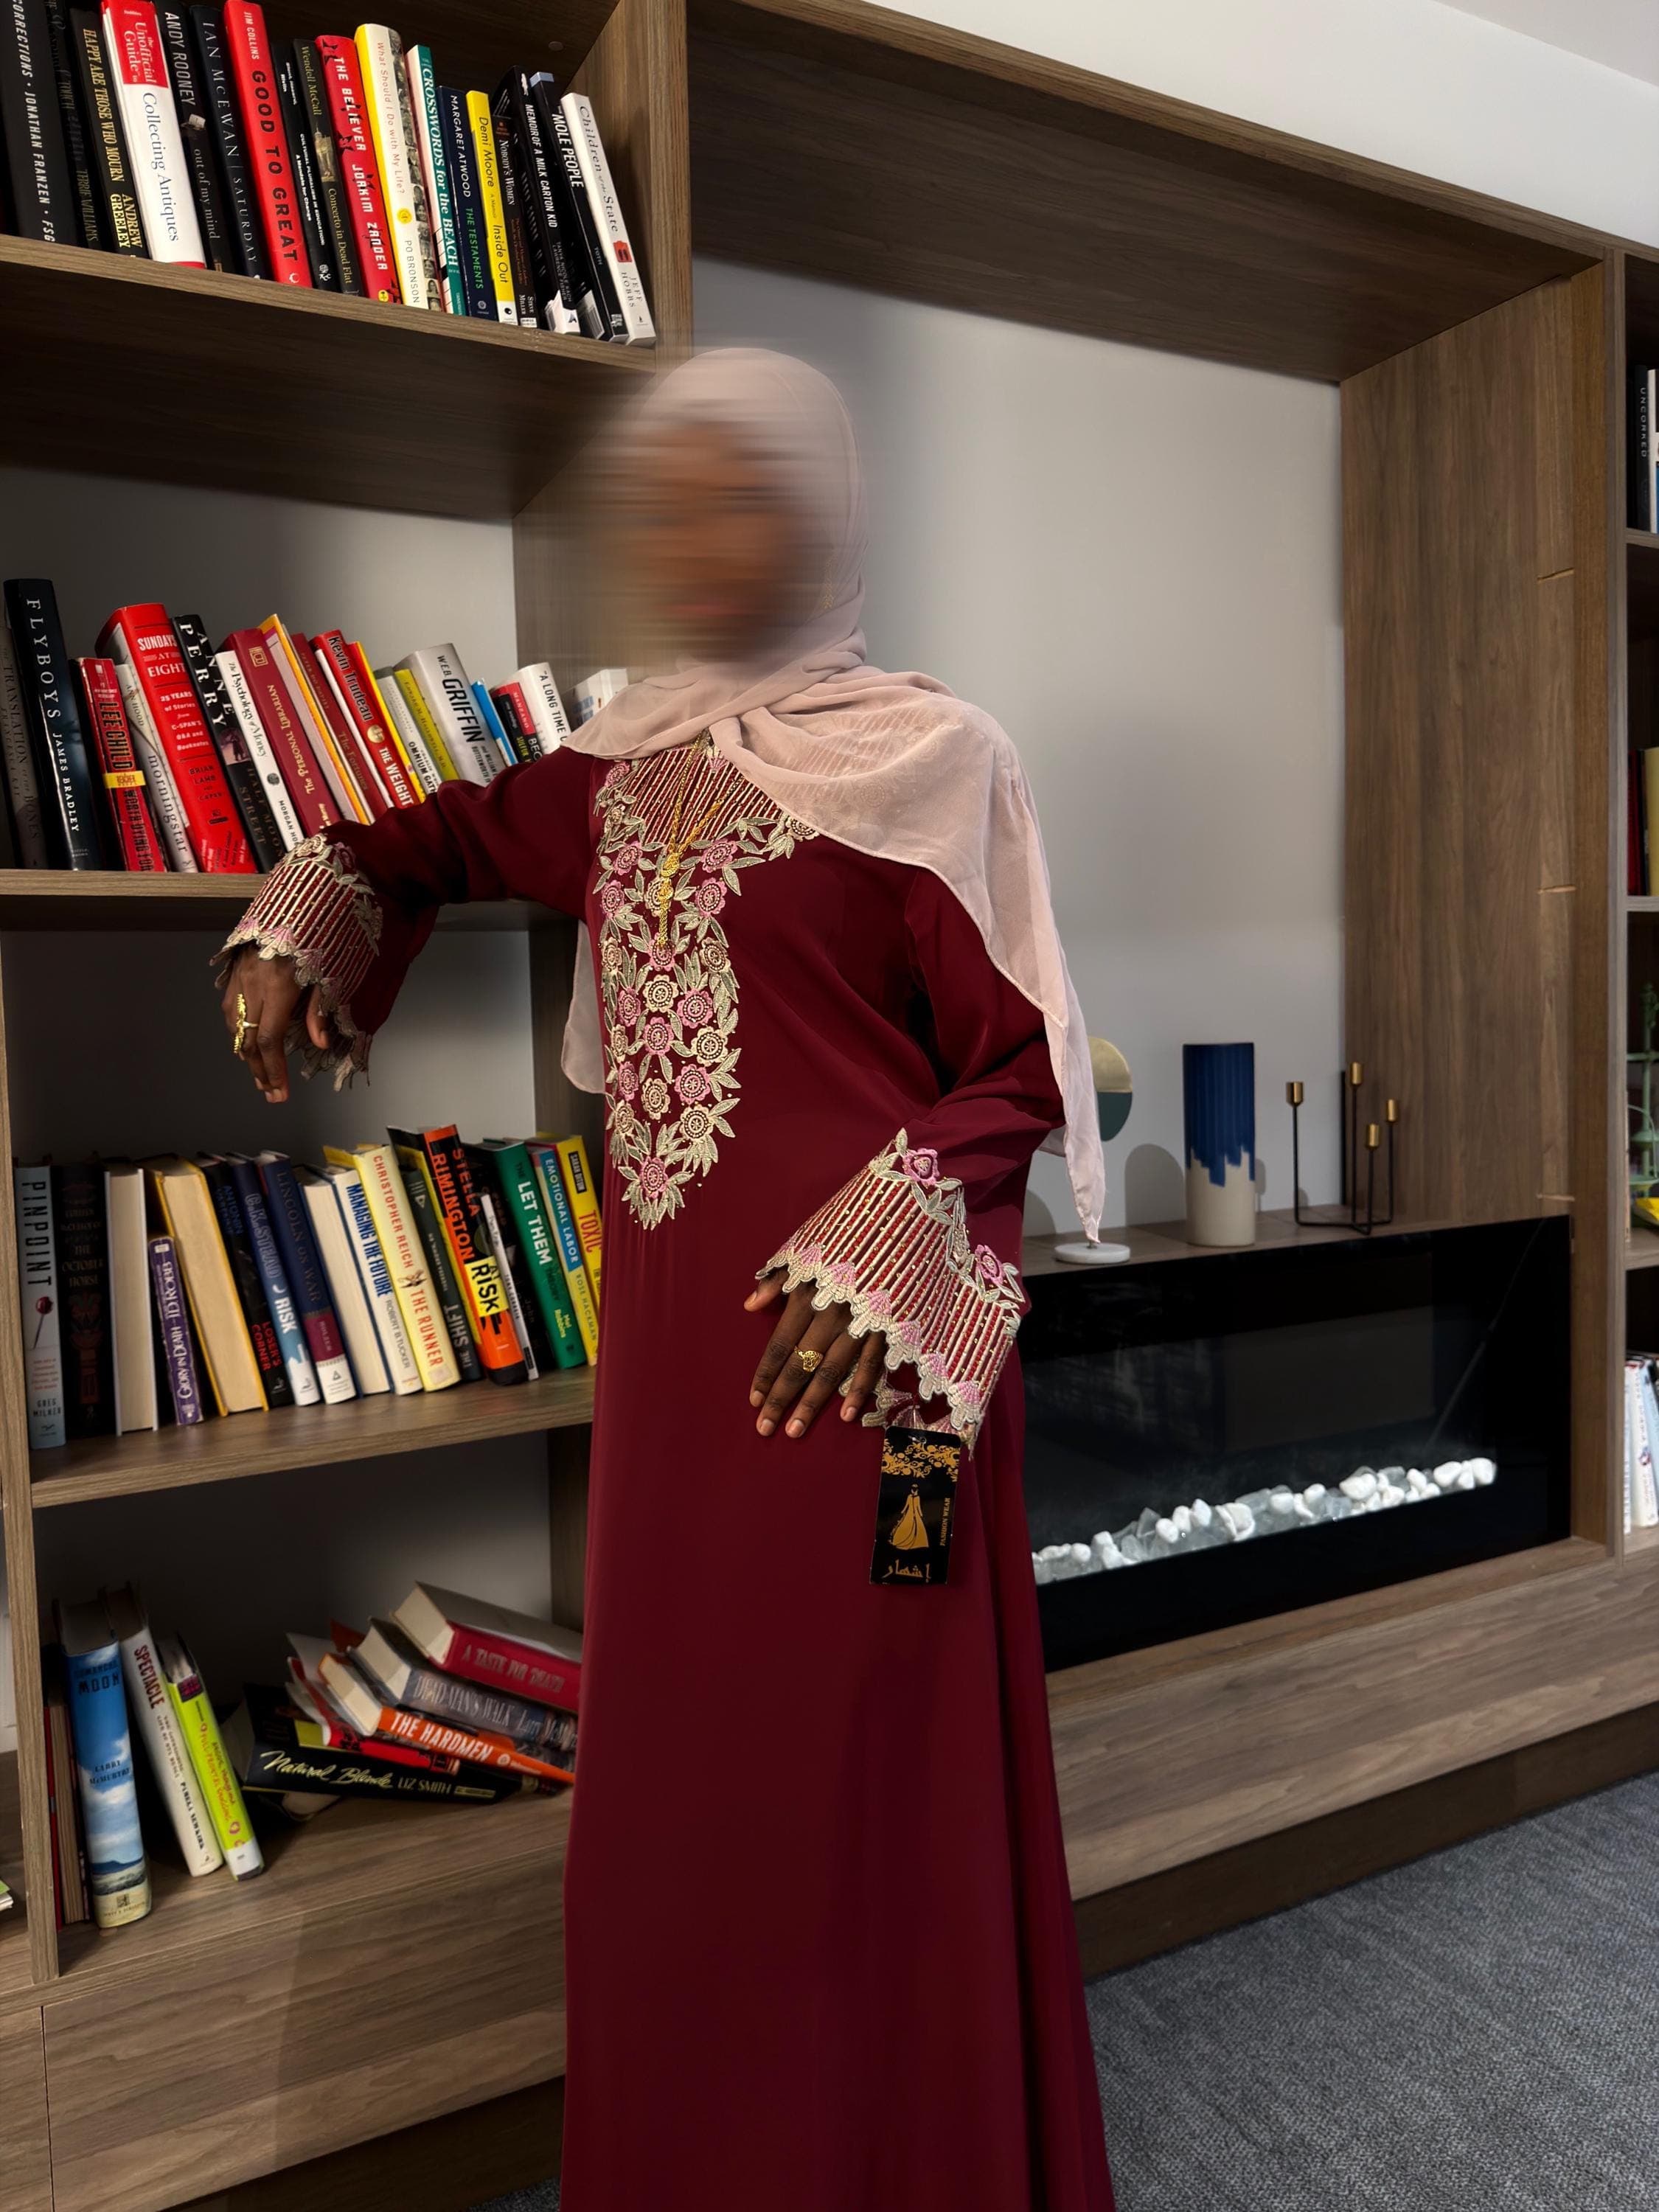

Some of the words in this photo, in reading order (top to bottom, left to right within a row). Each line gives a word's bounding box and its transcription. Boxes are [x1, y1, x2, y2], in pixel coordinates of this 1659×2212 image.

[164, 12, 184, 47] ANDY
[244, 11, 254, 25] JIM
[83, 28, 102, 62] HAPPY
[136, 22, 156, 83] Unofficial
[203, 23, 221, 58] IAN
[246, 27, 260, 60] COLLINS
[378, 42, 386, 66] What
[90, 62, 106, 86] ARE
[173, 52, 195, 105] ROONEY
[301, 46, 316, 82] Wendell
[309, 84, 322, 115] McCall
[334, 57, 349, 80] THE
[380, 70, 392, 102] Should
[94, 88, 112, 119] THOSE
[251, 70, 274, 132] GOOD
[341, 88, 366, 151] BELIEVER
[422, 68, 445, 167] CROSSWORDS
[101, 121, 116, 144] WHO
[386, 114, 394, 127] Do
[450, 95, 466, 150] MARGARET
[479, 116, 490, 147] Demi
[525, 104, 538, 136] MEMOIR
[552, 114, 572, 145] MOLE
[532, 137, 541, 147] OF
[580, 106, 602, 172] Children
[24, 91, 42, 147] JONATHAN
[33, 153, 50, 204] FRANZEN
[42, 219, 55, 242] FSG
[105, 147, 125, 182] MOURN
[143, 93, 165, 170] Collecting
[158, 175, 178, 241] Antiques
[194, 149, 204, 168] out
[265, 146, 282, 174] TO
[392, 153, 400, 167] My
[457, 152, 471, 198] ATWOOD
[484, 150, 494, 187] Moore
[535, 157, 548, 177] MILK
[561, 147, 584, 188] PEOPLE
[198, 173, 210, 186] of
[199, 187, 210, 204] my
[394, 170, 405, 193] Life?
[436, 169, 446, 189] for
[504, 176, 515, 205] WOMEN
[540, 180, 555, 212] CARTON
[81, 198, 99, 241] WILLIAMS
[110, 194, 131, 248] GREELEY
[122, 194, 142, 248] ANDREW
[234, 177, 257, 262] SATURDAY
[328, 188, 341, 228] Concerto
[352, 164, 374, 212] JOAKIM
[367, 222, 389, 270] ZANDER
[439, 193, 450, 214] the
[465, 208, 474, 227] THE
[547, 213, 558, 229] KID
[603, 195, 619, 232] State
[204, 209, 220, 238] mind
[273, 187, 297, 260] GREAT
[335, 228, 345, 240] in
[442, 218, 458, 265] BEACH
[493, 224, 506, 258] Inside
[338, 243, 350, 267] Dead
[405, 240, 413, 254] PO
[467, 228, 484, 289] TESTAMENTS
[594, 246, 604, 265] TOTH
[343, 267, 353, 284] Flat
[406, 257, 420, 304] BRONSON
[498, 262, 508, 283] Out
[621, 271, 636, 308] HOBBS
[630, 277, 642, 302] JEFF
[27, 598, 61, 719] FLYBOYS
[147, 664, 186, 678] EIGHT
[179, 624, 226, 726] PERRY
[198, 633, 235, 715] ANNE
[160, 694, 169, 702] 25
[170, 691, 192, 700] YEARS
[232, 673, 254, 720] Psychology
[328, 636, 350, 671] Kevin
[345, 671, 375, 722] Trudeau
[4, 666, 27, 763] TRANSLATION
[99, 702, 123, 728] LEE
[133, 703, 145, 726] HOOD
[173, 703, 195, 711] Stories
[268, 684, 291, 730] LIBRARIAN
[442, 678, 486, 743] GRIFFIN
[513, 693, 529, 728] MANZANO
[543, 684, 559, 709] LONG
[552, 711, 566, 734] TIME
[106, 729, 133, 769] CHILD
[251, 726, 267, 757] Money
[286, 731, 309, 778] PERSONAL
[408, 742, 428, 774] OMNIUM
[339, 731, 350, 751] The
[347, 751, 368, 790] Fortunes
[379, 745, 392, 764] THE
[386, 762, 414, 806] WEIGHT
[52, 732, 68, 773] JAMES
[62, 777, 80, 832] BRADLEY
[306, 777, 315, 795] The
[148, 755, 188, 852] morningstar
[239, 786, 267, 845] STREET
[279, 801, 293, 830] MORGAN
[451, 1147, 481, 1218] STELLA
[346, 1182, 375, 1239] MANAGING
[373, 1155, 403, 1233] CHRISTOPHER
[396, 1234, 414, 1268] REICH
[432, 1152, 476, 1260] RIMINGTON
[518, 1180, 538, 1211] LET
[528, 1214, 553, 1266] THEM
[545, 1158, 568, 1224] EMOTIONAL
[563, 1226, 579, 1263] LABOR
[21, 1181, 52, 1286] PINPOINT
[277, 1172, 303, 1242] LINCOLN
[304, 1267, 321, 1302] WAR
[363, 1240, 382, 1259] THE
[579, 1209, 602, 1253] TOXIC
[369, 1258, 393, 1297] FUTURE
[472, 1265, 499, 1312] RISK
[274, 1296, 297, 1335] RISK
[411, 1289, 429, 1315] THE
[563, 1313, 573, 1328] Mel
[262, 1321, 283, 1368] LOSER'S
[385, 1299, 400, 1329] ROBERT
[397, 1339, 411, 1369] TUCKER
[417, 1315, 444, 1366] RUNNER
[444, 1304, 469, 1349] SHIFT
[251, 1324, 272, 1371] CORNER
[459, 1349, 472, 1368] THE
[32, 1409, 62, 1418] MILNER
[939, 1516, 947, 1547] FASHION
[134, 1644, 165, 1709] SPECTACLE
[461, 1644, 473, 1663] A
[474, 1646, 509, 1674] TASTE
[504, 1659, 529, 1680] FOR
[78, 1674, 120, 1696] MOON
[414, 1675, 448, 1704] DEAD
[481, 1697, 515, 1726] WALK
[390, 1711, 420, 1738] THE
[418, 1721, 495, 1762] HARDMEN
[260, 1749, 338, 1781] Natural
[327, 1766, 394, 1790] Blonde
[398, 1775, 417, 1790] LIZ
[418, 1778, 452, 1795] SMITH
